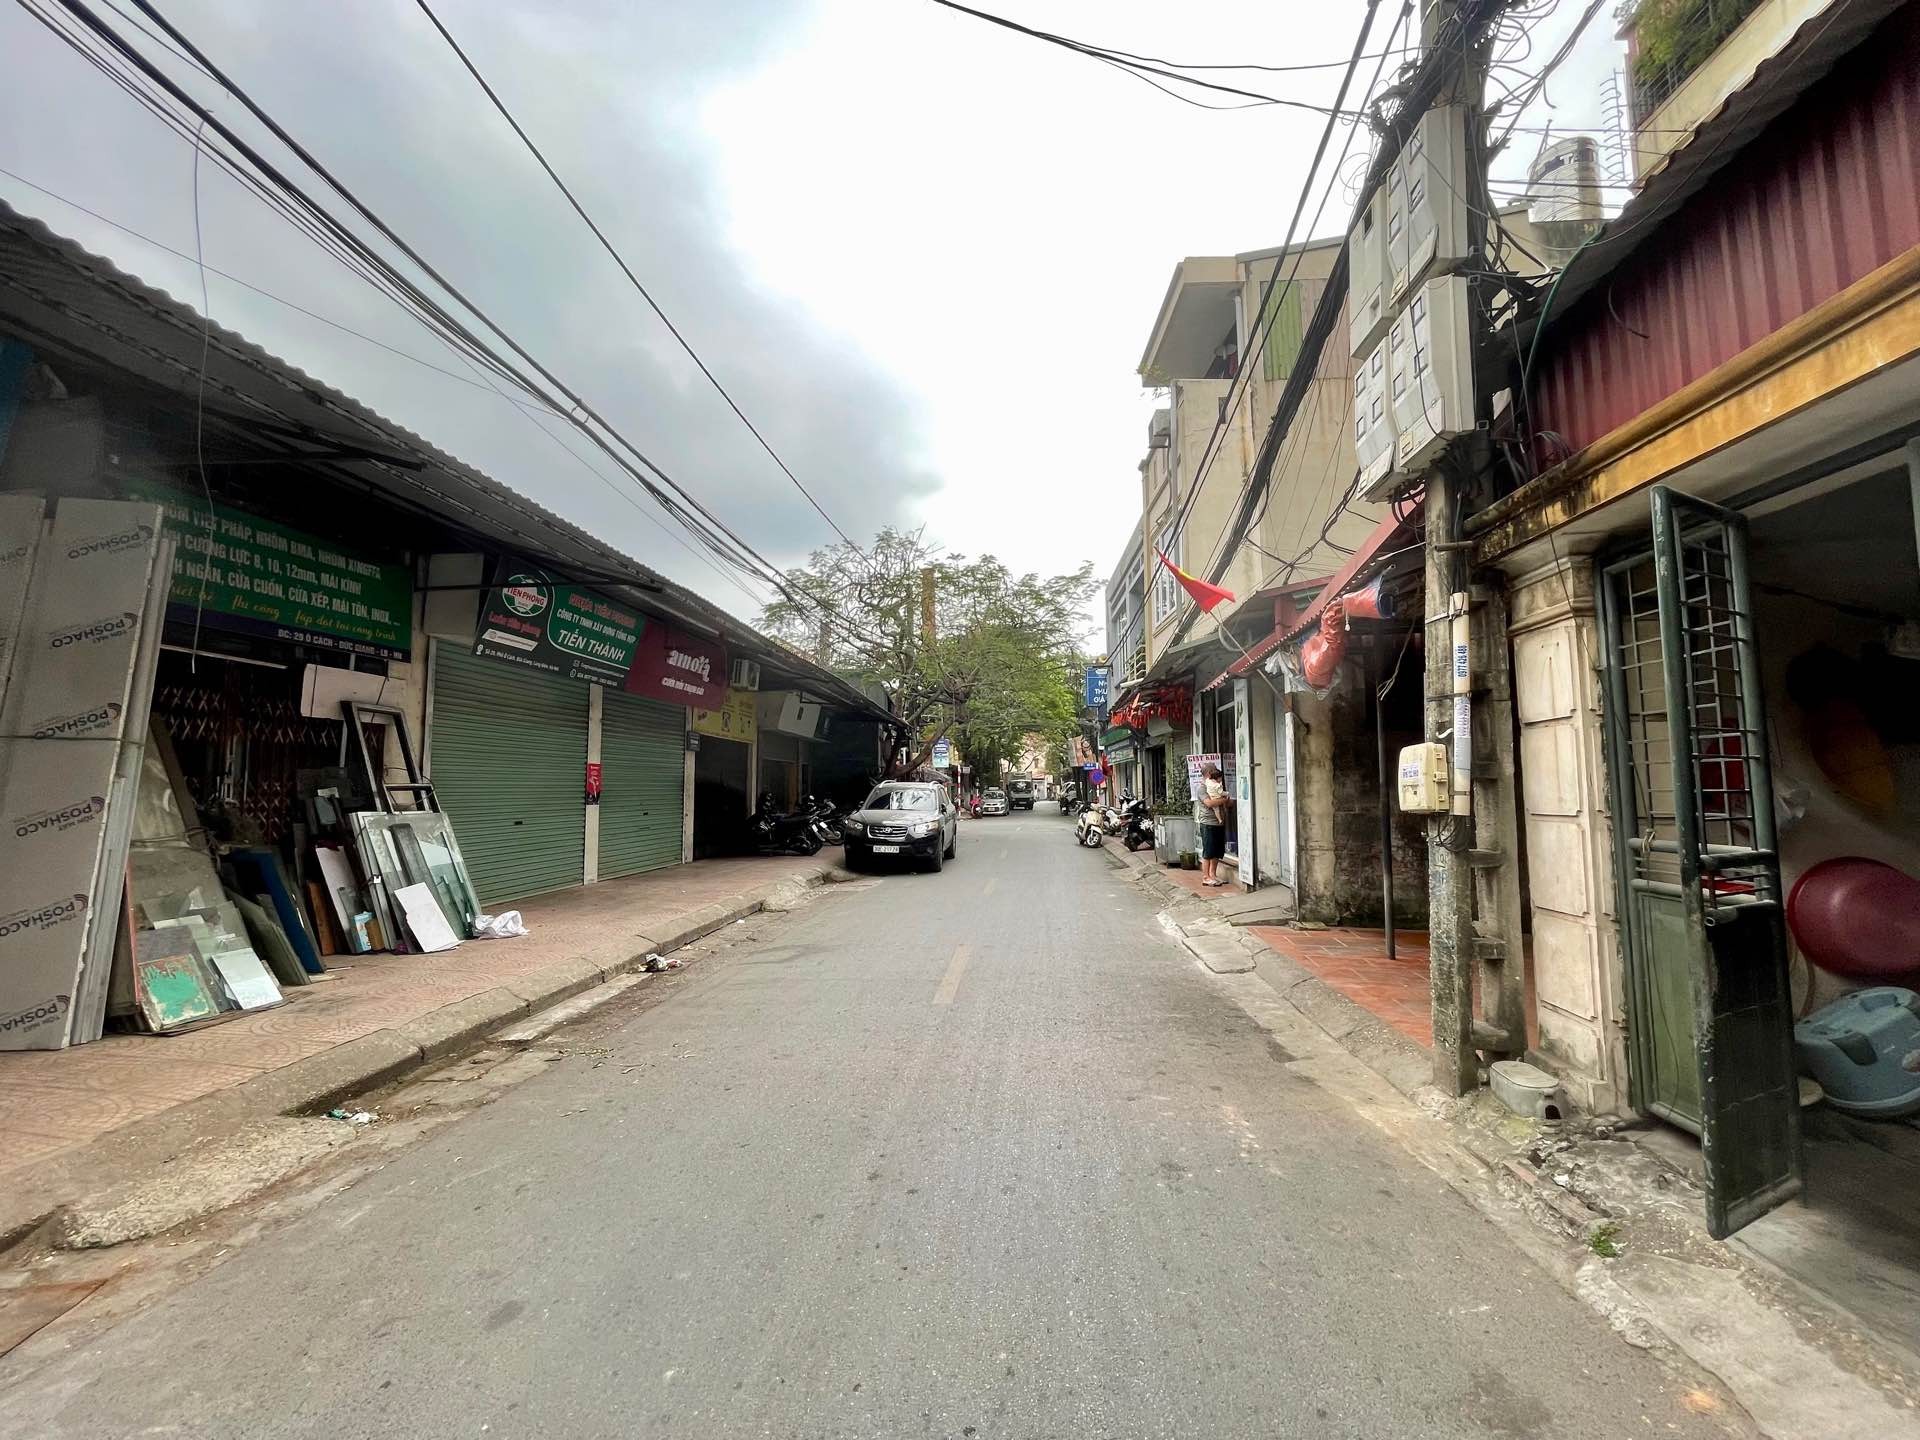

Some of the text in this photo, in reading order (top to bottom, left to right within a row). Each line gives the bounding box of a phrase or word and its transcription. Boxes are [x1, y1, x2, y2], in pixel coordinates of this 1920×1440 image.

[68, 532, 140, 559] POSHACO
[229, 547, 251, 567] LỰC
[268, 558, 283, 577] 10,
[286, 563, 318, 585] 12mm,
[320, 572, 339, 590] MÁI
[228, 568, 250, 590] CỬA
[254, 577, 285, 600] CUỐN,
[288, 584, 308, 604] CỬA
[310, 590, 330, 610] XẾP,
[332, 598, 349, 614] MÁI
[52, 619, 125, 648] POSHACO
[313, 635, 333, 647] CÁCH
[588, 640, 626, 662] THÀNH
[34, 708, 109, 739] POSHACO
[16, 803, 92, 837] POSHACO
[0, 901, 75, 937] POSHACO
[0, 1002, 58, 1031] POSHA
